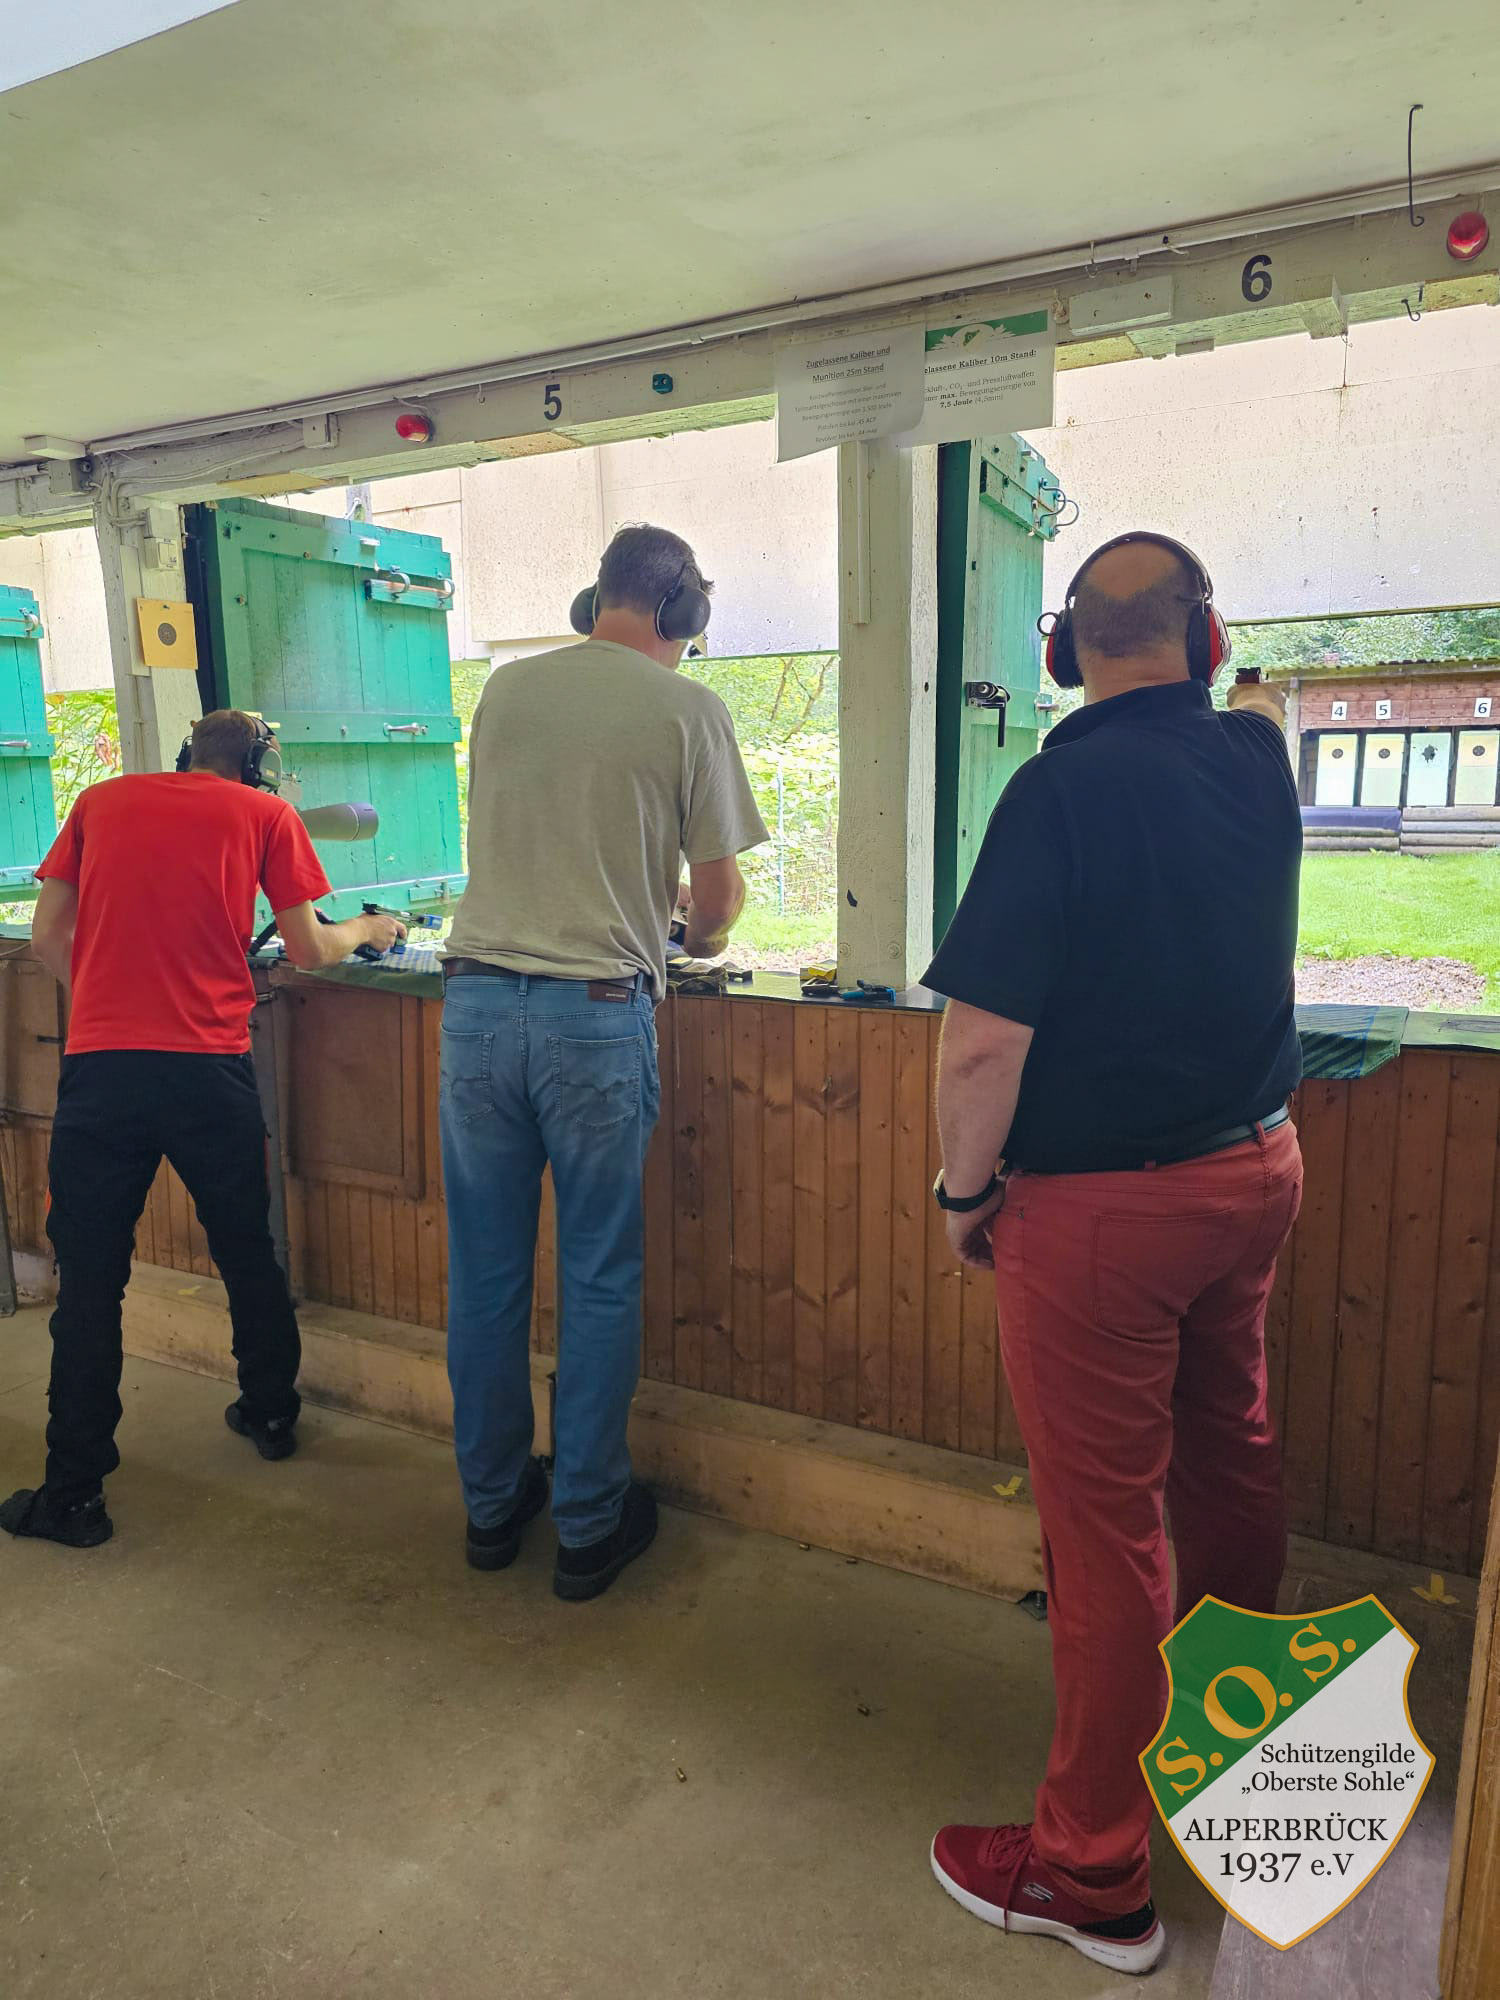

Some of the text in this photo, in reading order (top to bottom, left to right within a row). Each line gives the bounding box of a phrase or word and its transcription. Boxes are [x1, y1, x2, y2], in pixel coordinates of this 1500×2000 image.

[1241, 254, 1272, 302] 6
[806, 345, 891, 369] Zugelassene Kaliber und
[959, 358, 988, 369] Kaliber
[991, 355, 1008, 364] 10m
[1010, 349, 1037, 360] Stand:
[812, 362, 885, 383] Munition 25m Stand
[967, 378, 981, 388] und
[543, 383, 563, 421] 5
[940, 392, 958, 401] max.
[939, 400, 952, 409] 7,5
[953, 398, 973, 407] Joule
[1334, 705, 1344, 717] 4
[1378, 704, 1388, 716] 5
[1477, 702, 1487, 714] 6
